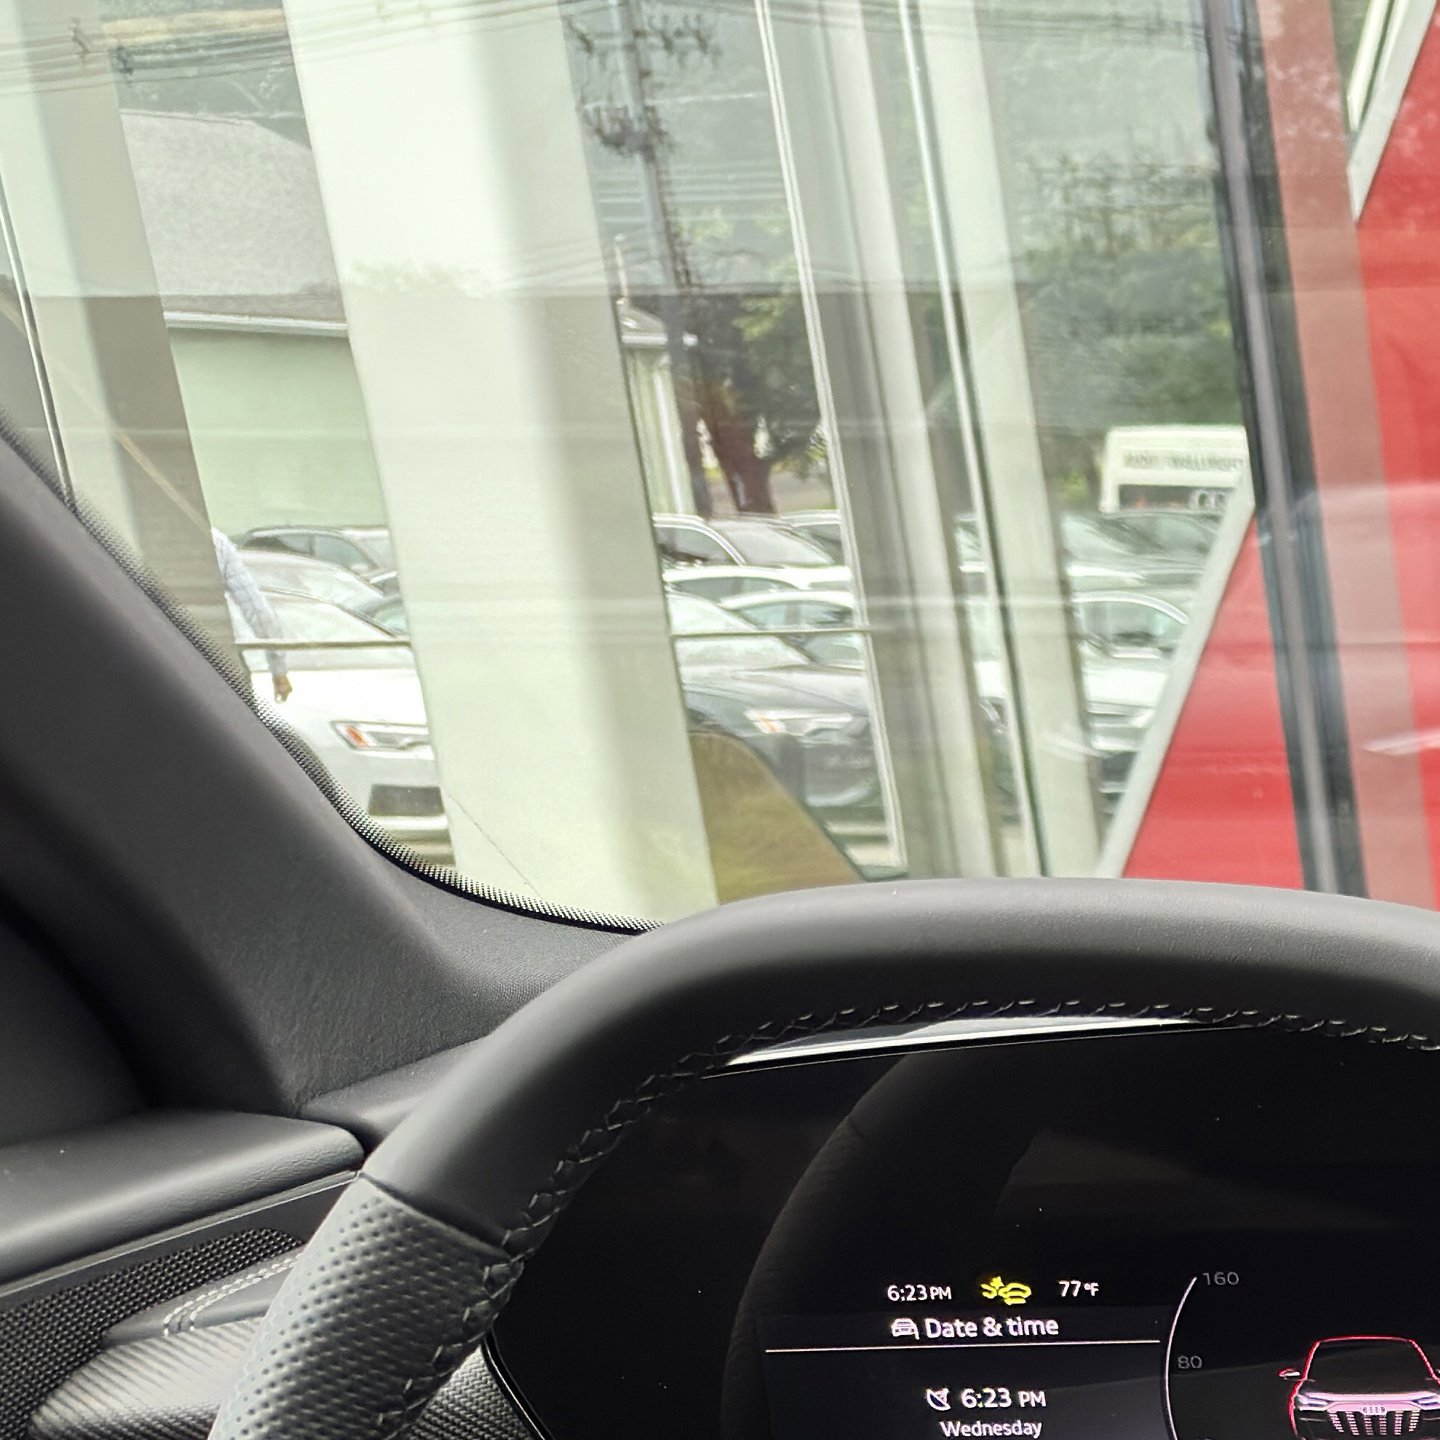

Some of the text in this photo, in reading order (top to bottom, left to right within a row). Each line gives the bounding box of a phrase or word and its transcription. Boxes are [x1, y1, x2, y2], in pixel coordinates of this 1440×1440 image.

[1203, 1271, 1239, 1286] 160
[924, 1316, 1059, 1339] Date & time
[1177, 1355, 1203, 1369] 80
[961, 1387, 1047, 1408] 6:23 PM
[939, 1420, 1042, 1439] Wednesday
